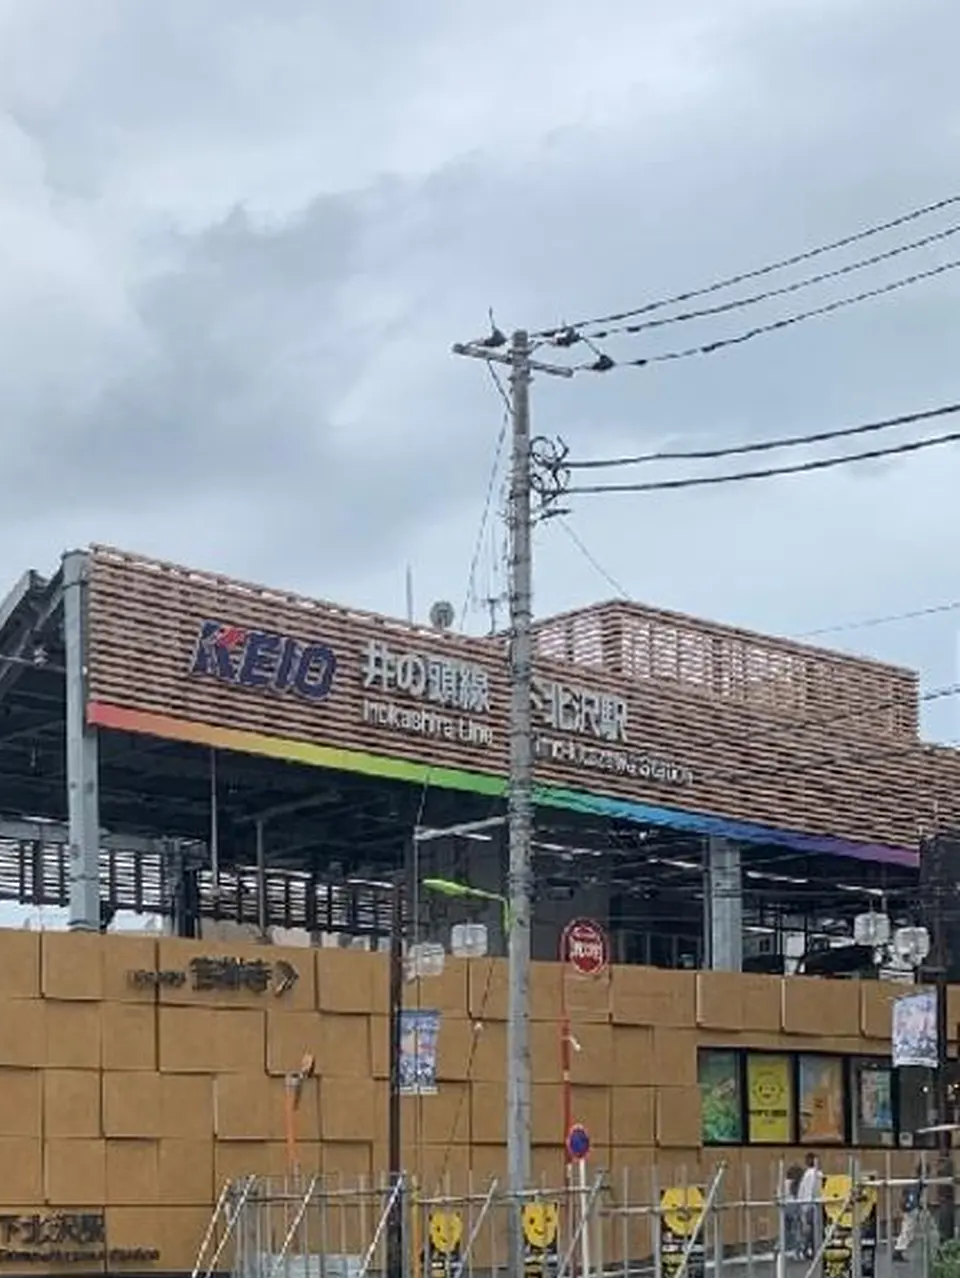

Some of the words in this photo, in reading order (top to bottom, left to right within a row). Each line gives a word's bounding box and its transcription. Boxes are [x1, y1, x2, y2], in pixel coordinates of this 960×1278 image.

[187, 619, 338, 699] KEIO
[361, 639, 490, 713] 井の頭線
